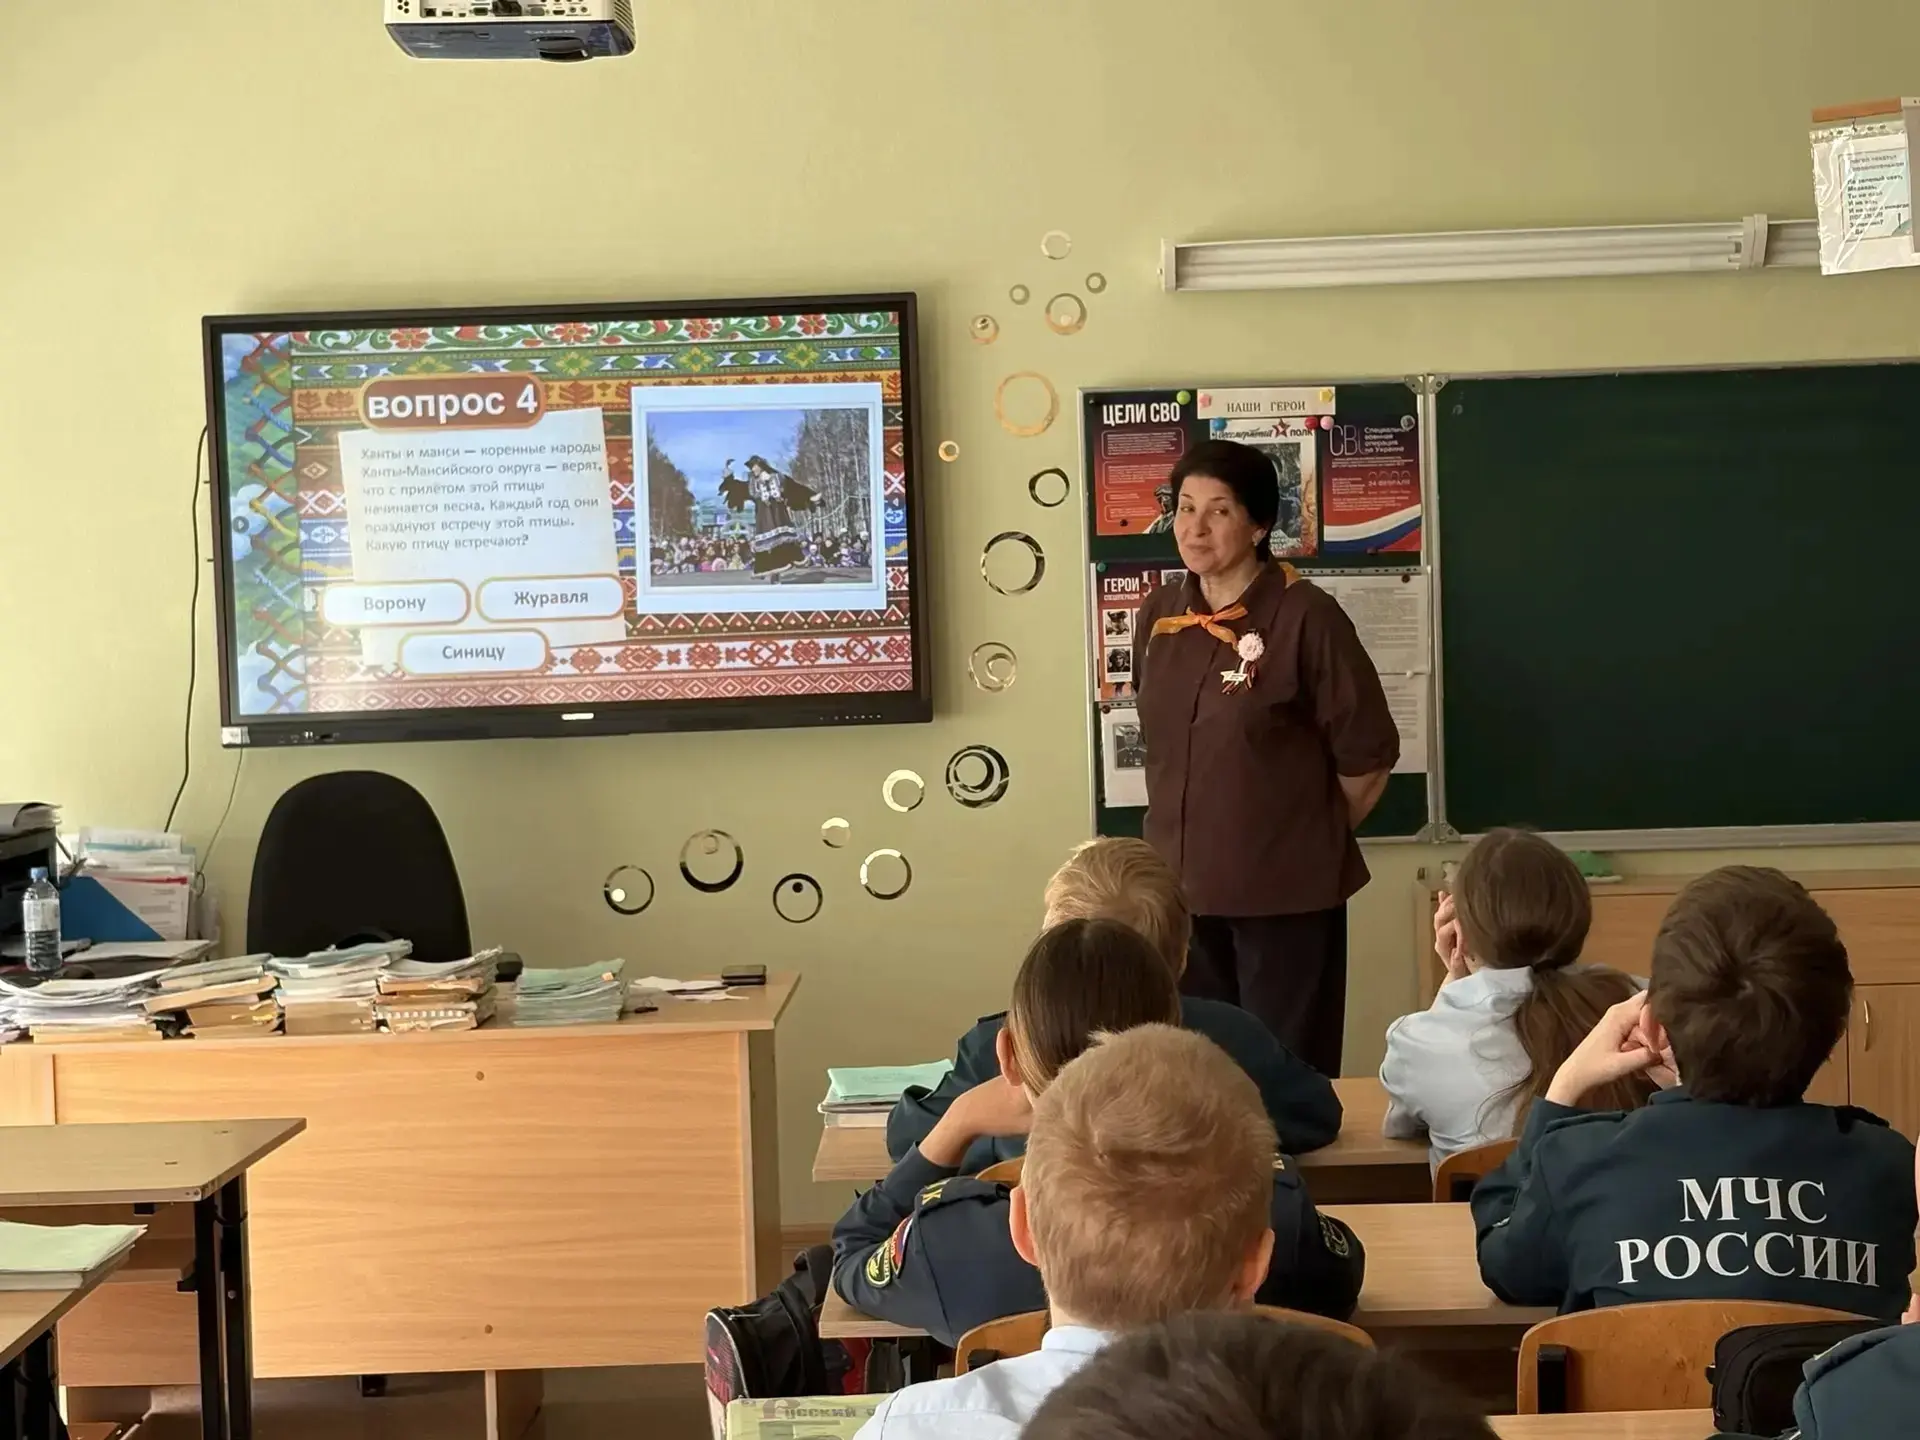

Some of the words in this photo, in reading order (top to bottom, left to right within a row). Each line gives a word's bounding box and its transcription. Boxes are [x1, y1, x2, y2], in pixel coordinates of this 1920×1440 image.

[368, 391, 505, 424] вопрос
[516, 383, 538, 414] 4
[1227, 402, 1261, 413] НАШИ
[1270, 401, 1306, 412] ГЕРОИ
[1103, 403, 1147, 427] ЦЕЛИ
[1150, 402, 1181, 423] СВО
[361, 448, 401, 461] Ханты
[406, 450, 414, 458] и
[419, 448, 460, 458] манси
[480, 446, 546, 459] коренные
[551, 443, 601, 457] народы
[362, 464, 494, 478] Ханты-Мансийского
[498, 464, 541, 477] округа
[363, 487, 384, 496] что
[389, 487, 395, 495] с
[470, 481, 499, 493] этой
[504, 482, 545, 494] птицы
[364, 503, 439, 515] начинается
[443, 502, 485, 512] весна.
[490, 498, 543, 512] Каждый
[548, 499, 570, 510] год
[574, 499, 599, 508] они
[365, 520, 435, 535] празднуют
[441, 518, 491, 532] встречу
[496, 517, 525, 529] этой
[529, 517, 575, 530] птицы.
[366, 538, 407, 552] Какую
[412, 540, 449, 552] птицу
[454, 535, 529, 550] встречают?
[1104, 577, 1140, 593] ГЕРОИ
[363, 596, 427, 612] Ворону
[514, 590, 589, 608] Журавля
[442, 645, 505, 661] Синицу
[1677, 1176, 1828, 1224] МЧС
[1614, 1231, 1880, 1288] РОССИИ
